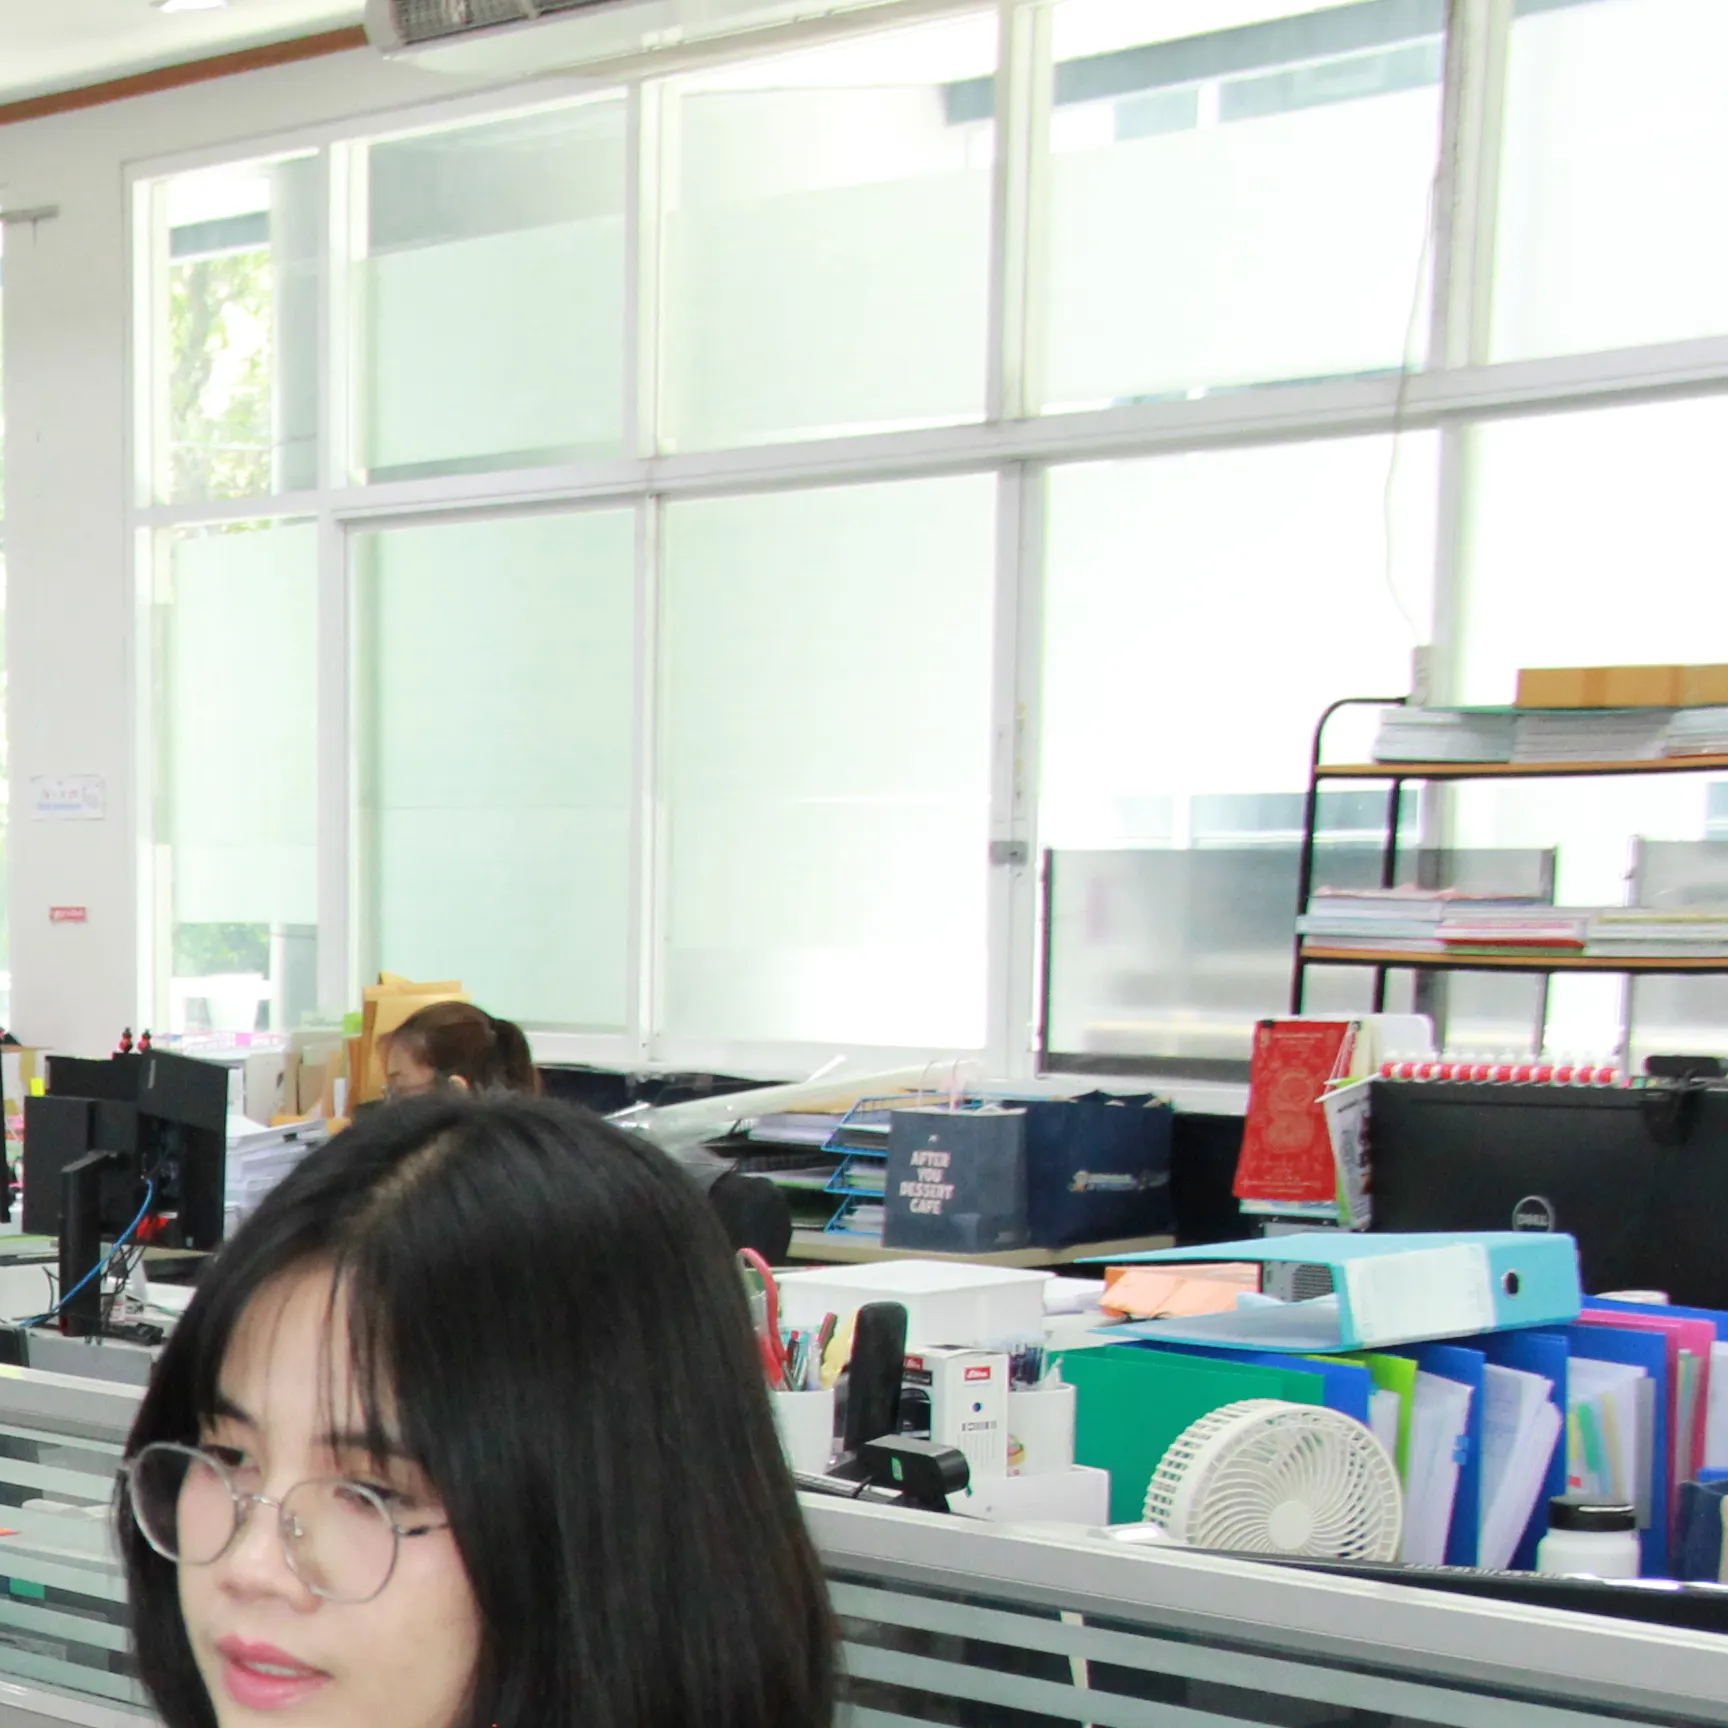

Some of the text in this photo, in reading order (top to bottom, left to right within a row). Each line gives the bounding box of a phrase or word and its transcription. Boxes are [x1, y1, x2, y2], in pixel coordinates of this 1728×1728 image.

[910, 1150, 951, 1168] AFTER
[917, 1167, 944, 1183] YOU
[899, 1181, 955, 1200] DESSERT
[909, 1198, 943, 1215] CAFE
